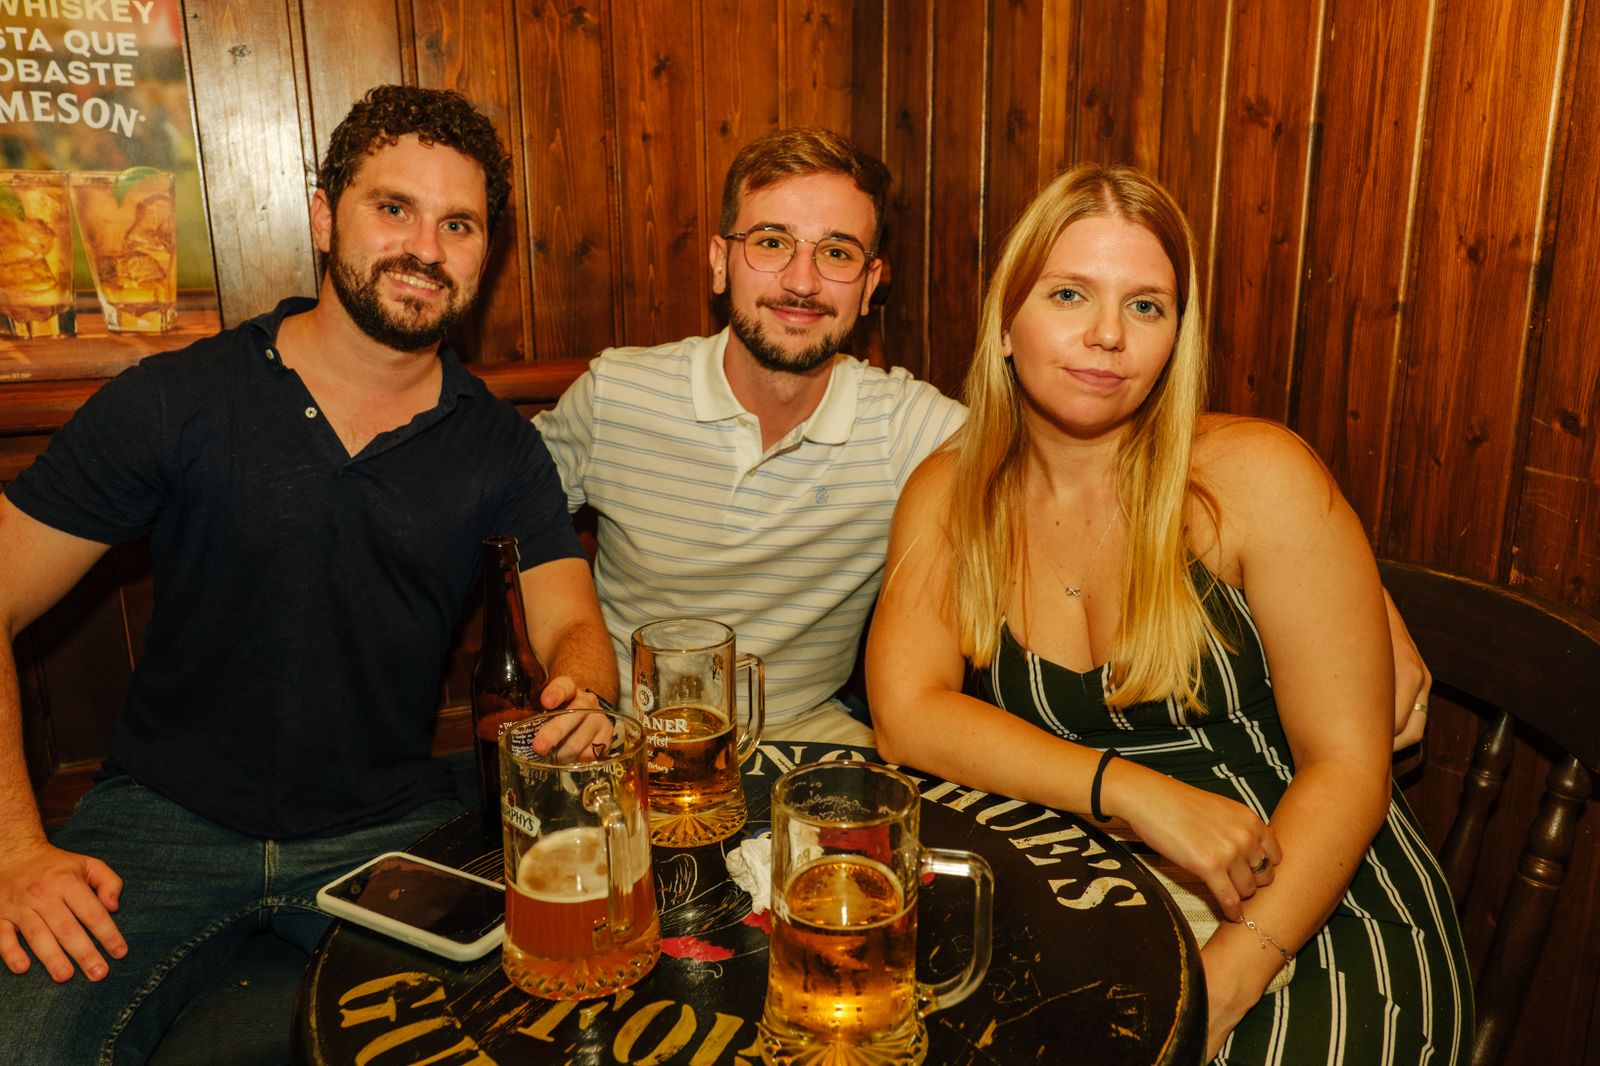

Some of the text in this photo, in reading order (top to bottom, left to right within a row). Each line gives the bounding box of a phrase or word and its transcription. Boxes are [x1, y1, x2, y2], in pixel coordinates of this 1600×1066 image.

[0, 0, 155, 24] WHISKEY
[64, 30, 139, 58] QUE
[0, 57, 135, 87] OBASTE
